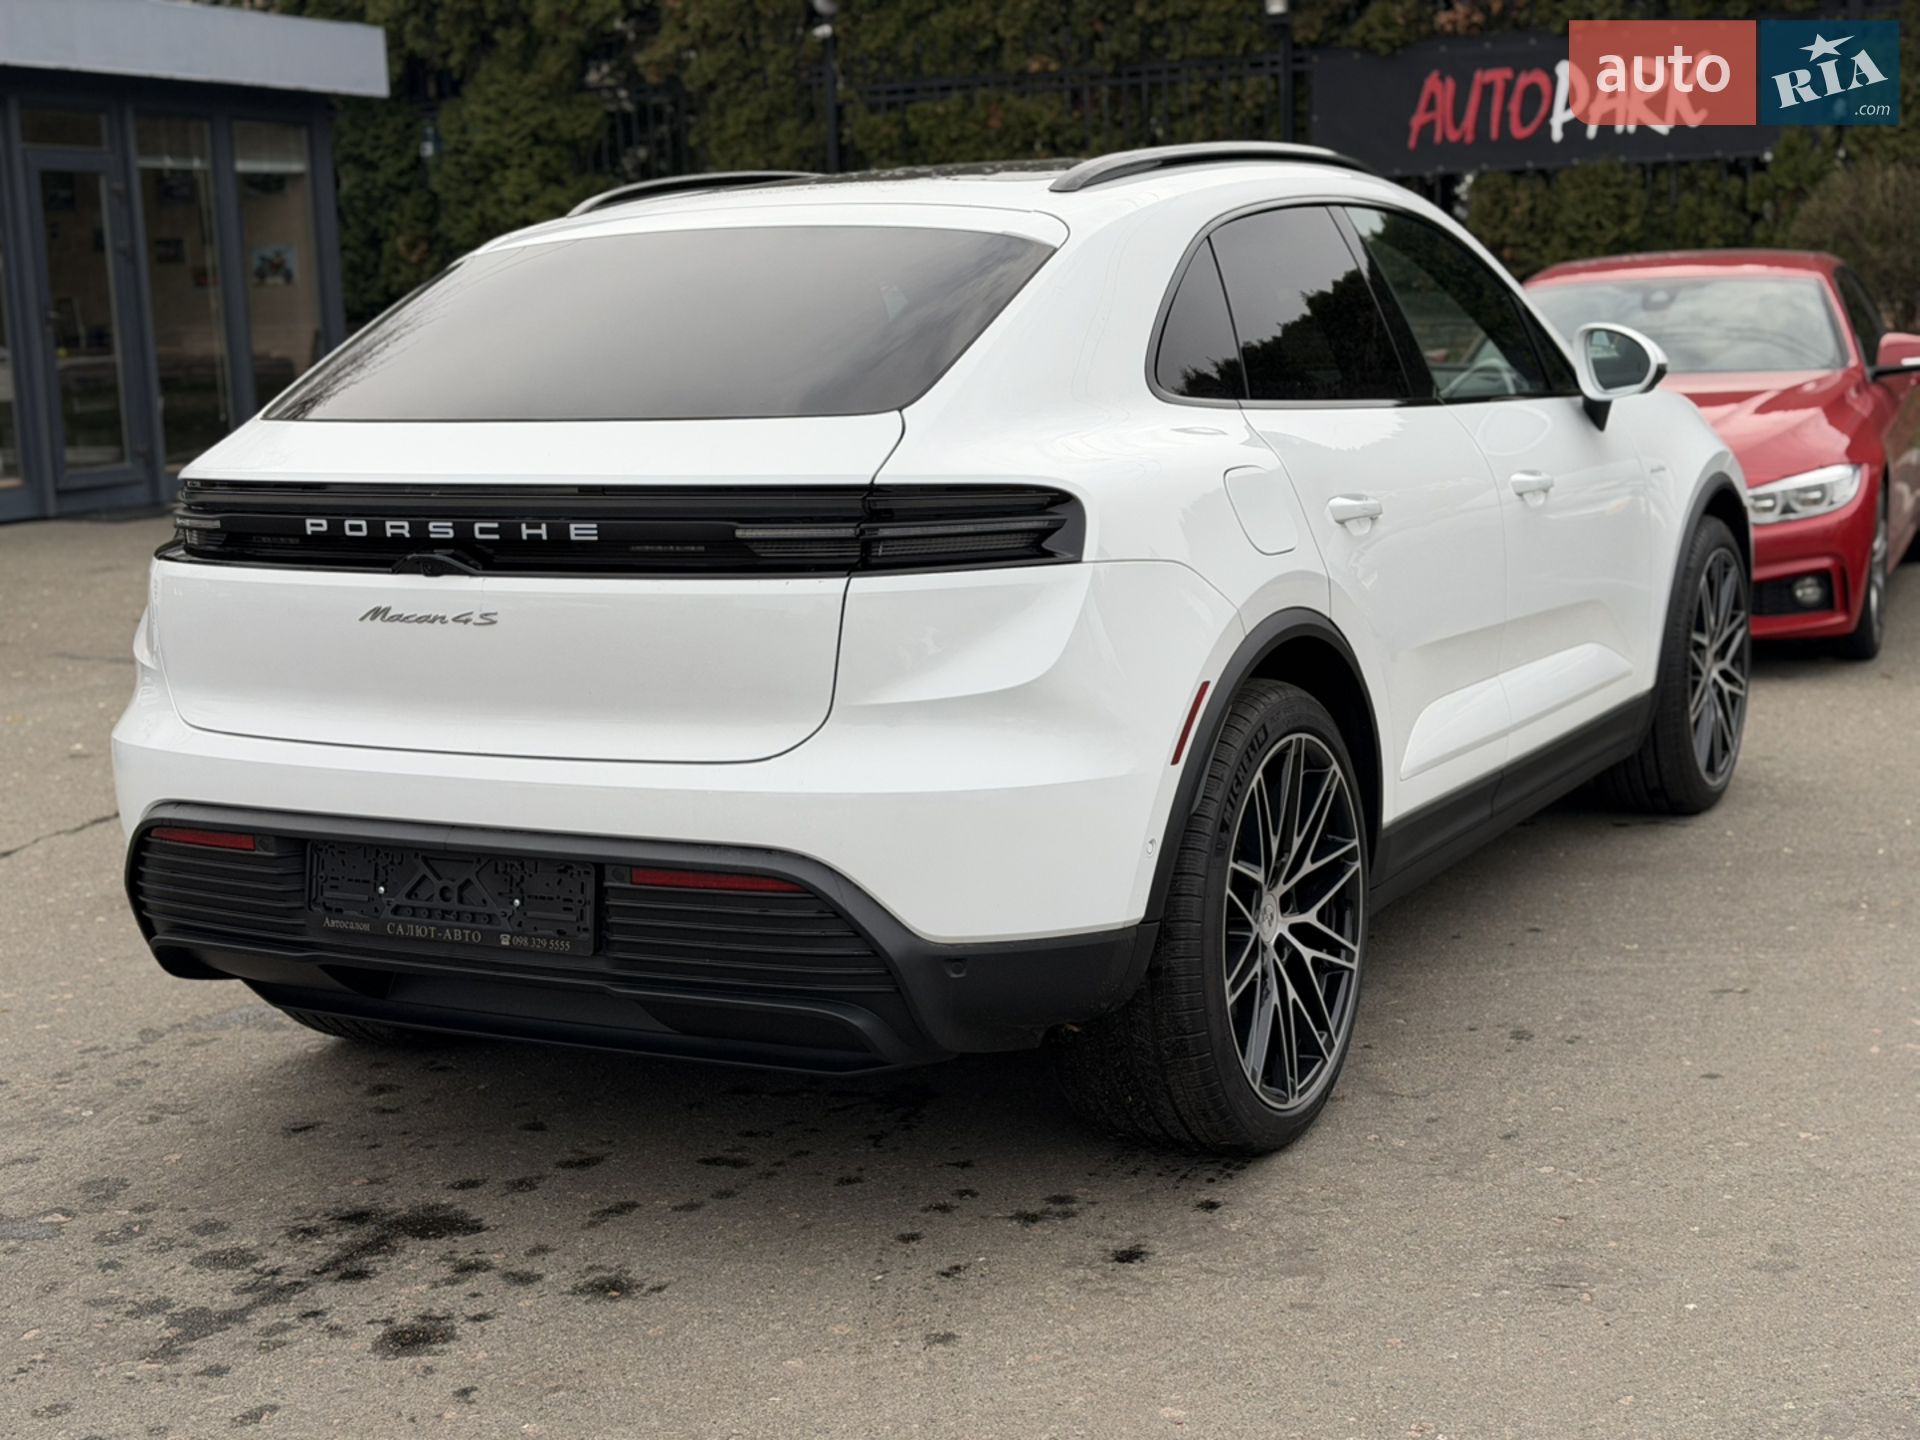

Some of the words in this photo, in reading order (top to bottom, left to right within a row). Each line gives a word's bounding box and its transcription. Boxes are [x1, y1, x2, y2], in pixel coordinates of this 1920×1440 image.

[1407, 49, 1711, 150] AUTOPARK
[305, 518, 599, 541] PORSCHE
[358, 604, 449, 625] Macan
[450, 610, 499, 627] 4S
[1220, 722, 1270, 833] MICHELIN
[323, 915, 371, 932] Автосалон
[386, 921, 483, 944] САЛЮТ-АВТО
[511, 935, 529, 948] 098
[530, 937, 547, 949] 329
[548, 938, 571, 951] 5555
